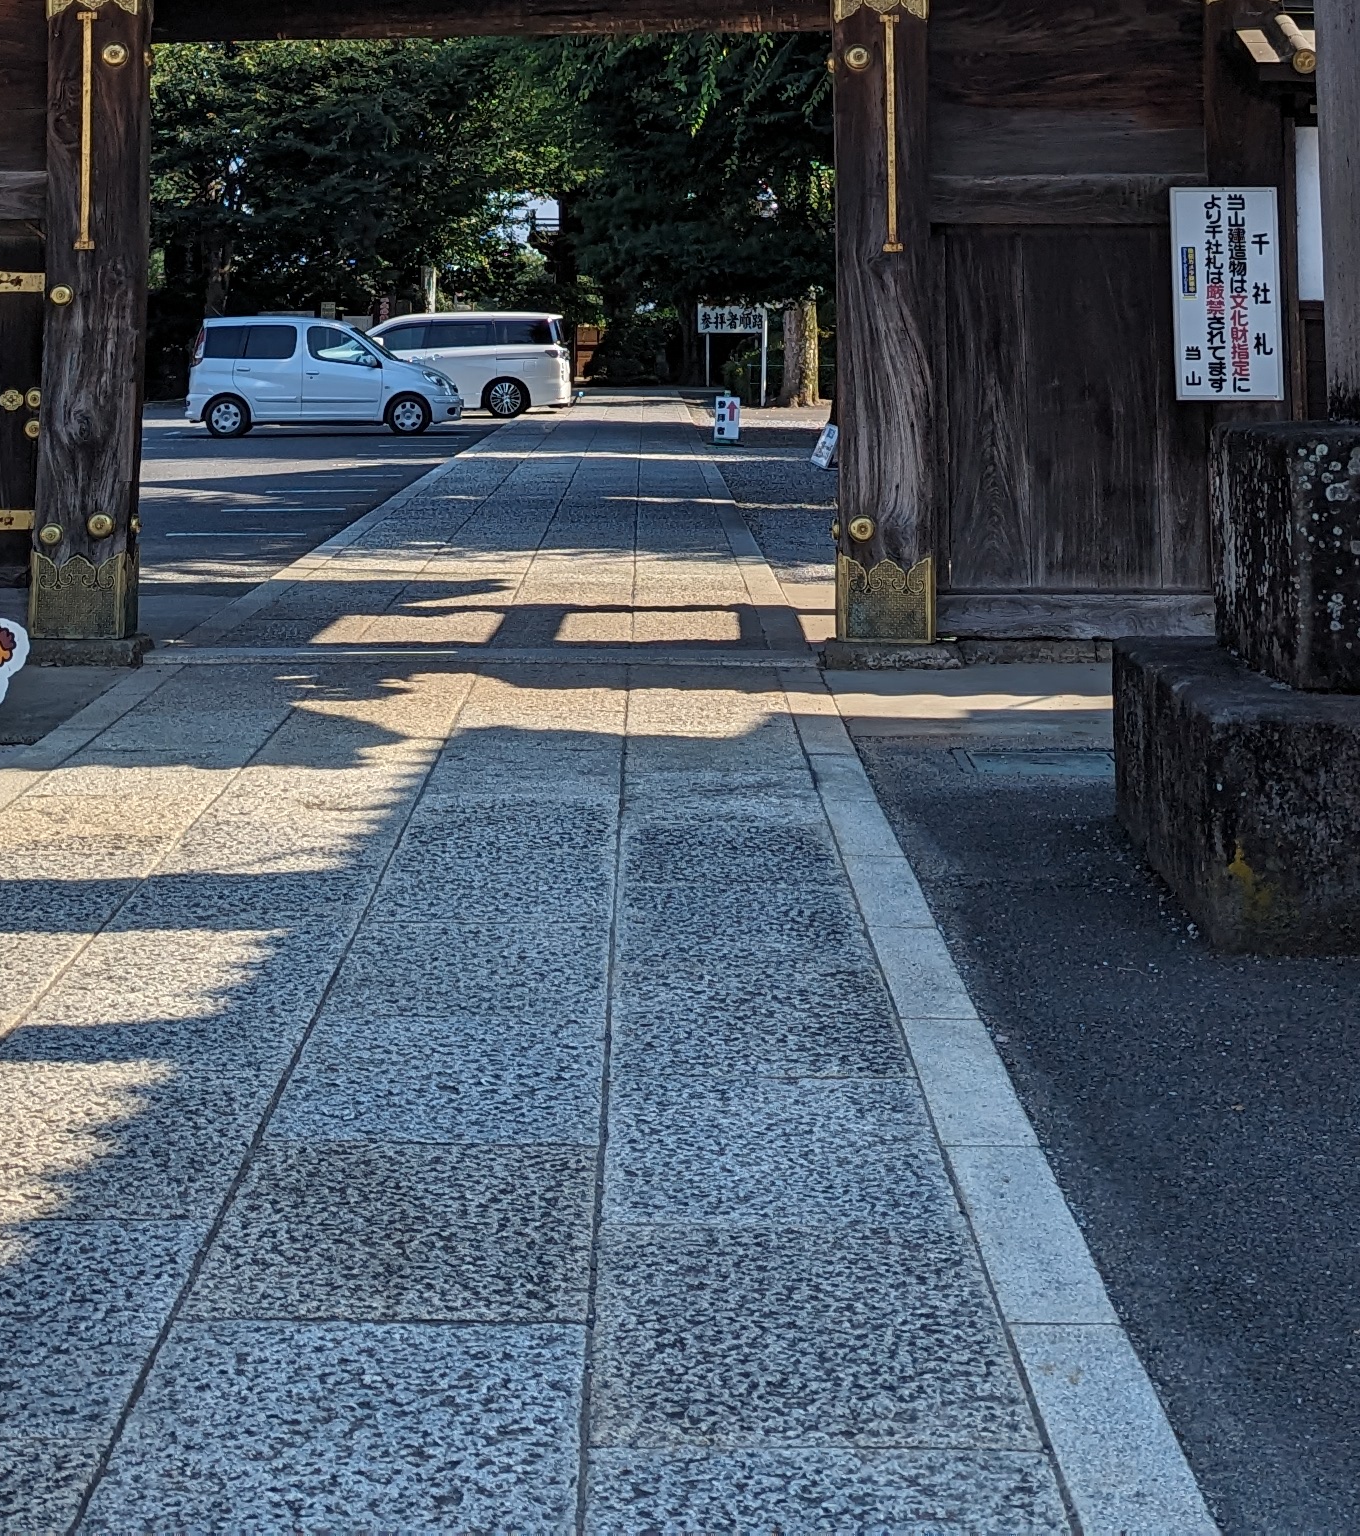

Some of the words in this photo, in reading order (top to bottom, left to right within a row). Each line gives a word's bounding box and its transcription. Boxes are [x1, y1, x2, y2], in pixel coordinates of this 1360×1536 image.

[700, 311, 763, 330] 参拝者順路
[1204, 194, 1228, 393] より千社札は厳禁されてます
[1227, 194, 1251, 393] 当山建造物は文化財指定に
[1251, 233, 1273, 355] 千社札
[1185, 345, 1202, 386] 当山
